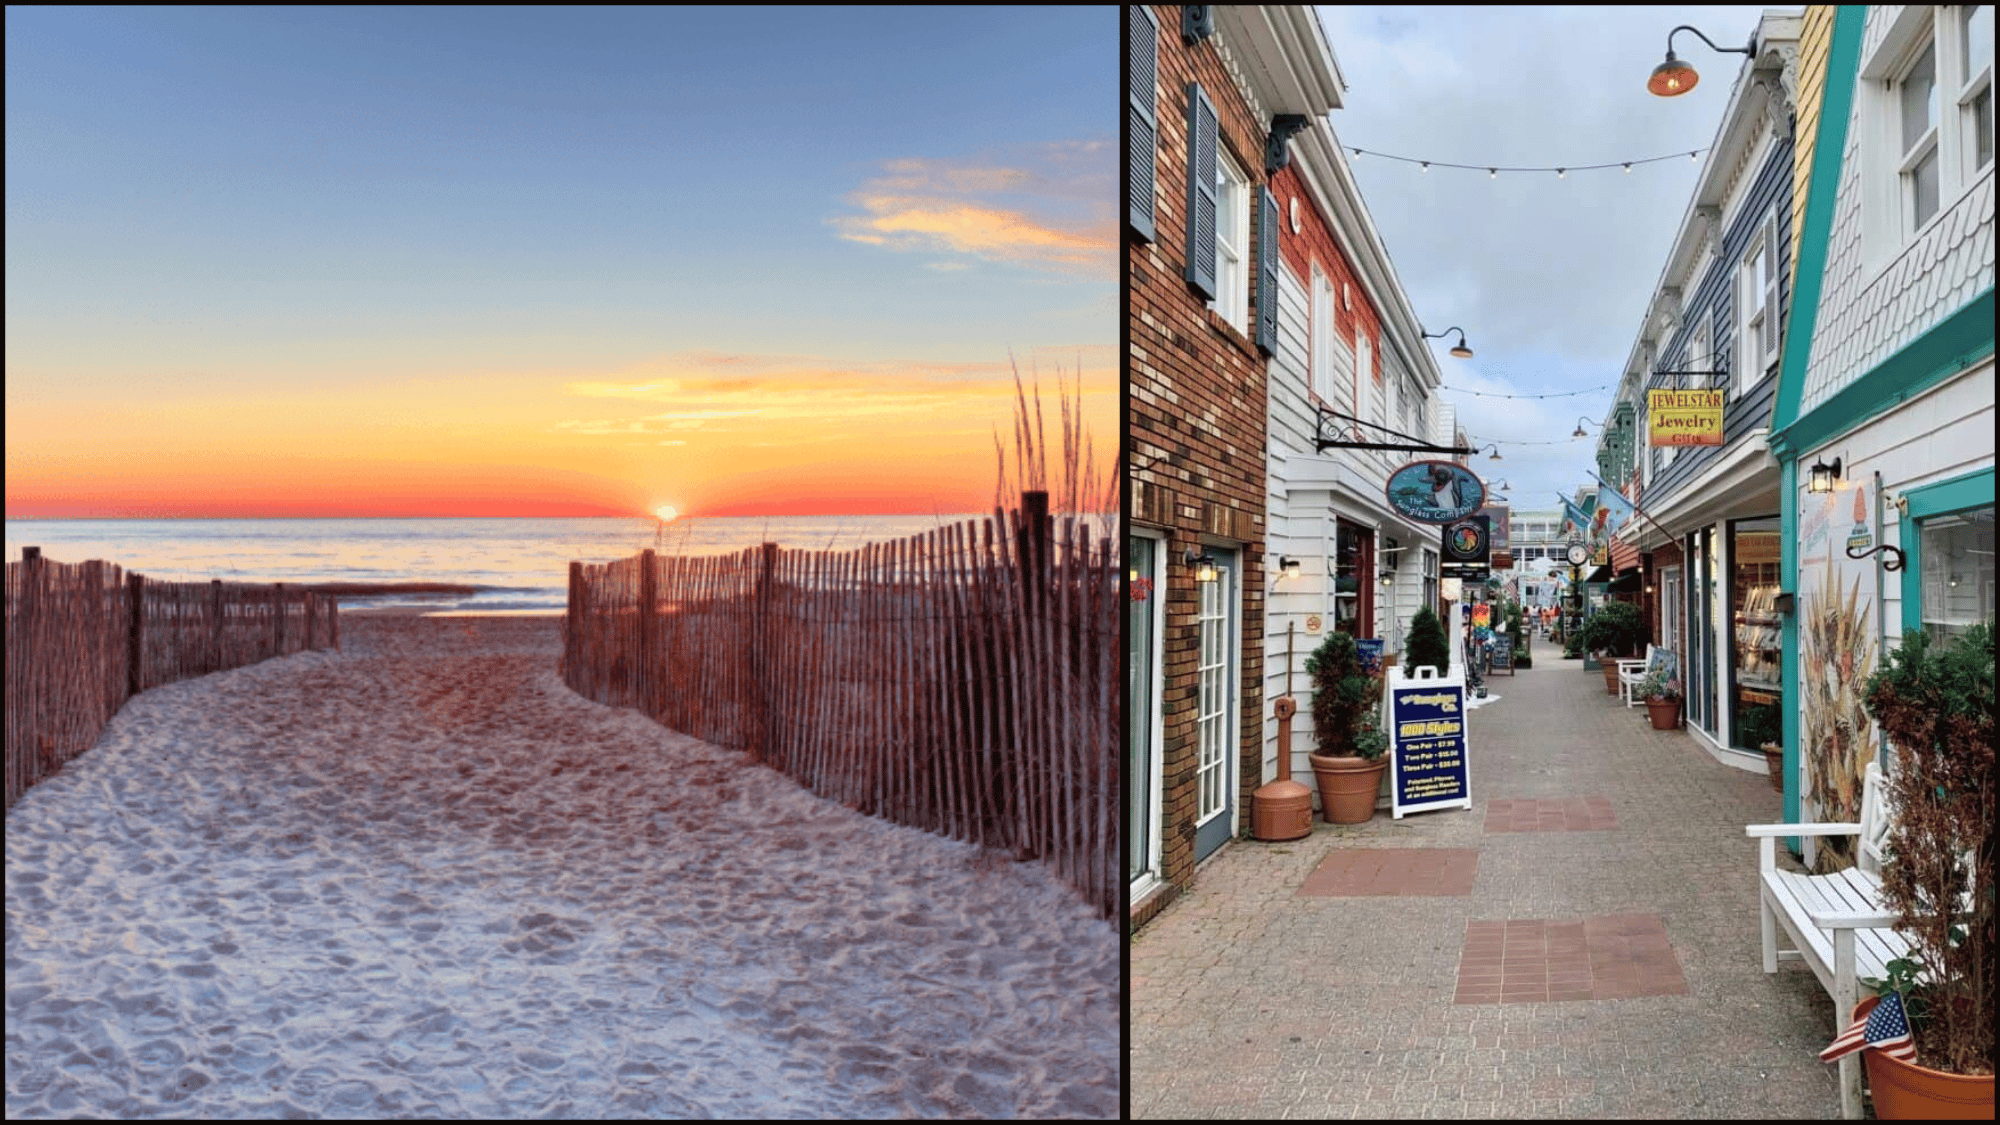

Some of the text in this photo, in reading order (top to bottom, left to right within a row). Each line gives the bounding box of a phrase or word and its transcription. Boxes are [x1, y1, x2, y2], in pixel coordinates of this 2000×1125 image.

[1653, 393, 1721, 410] JEWELSTAR
[1657, 414, 1716, 431] Jewelry
[1426, 721, 1460, 736] Styles
